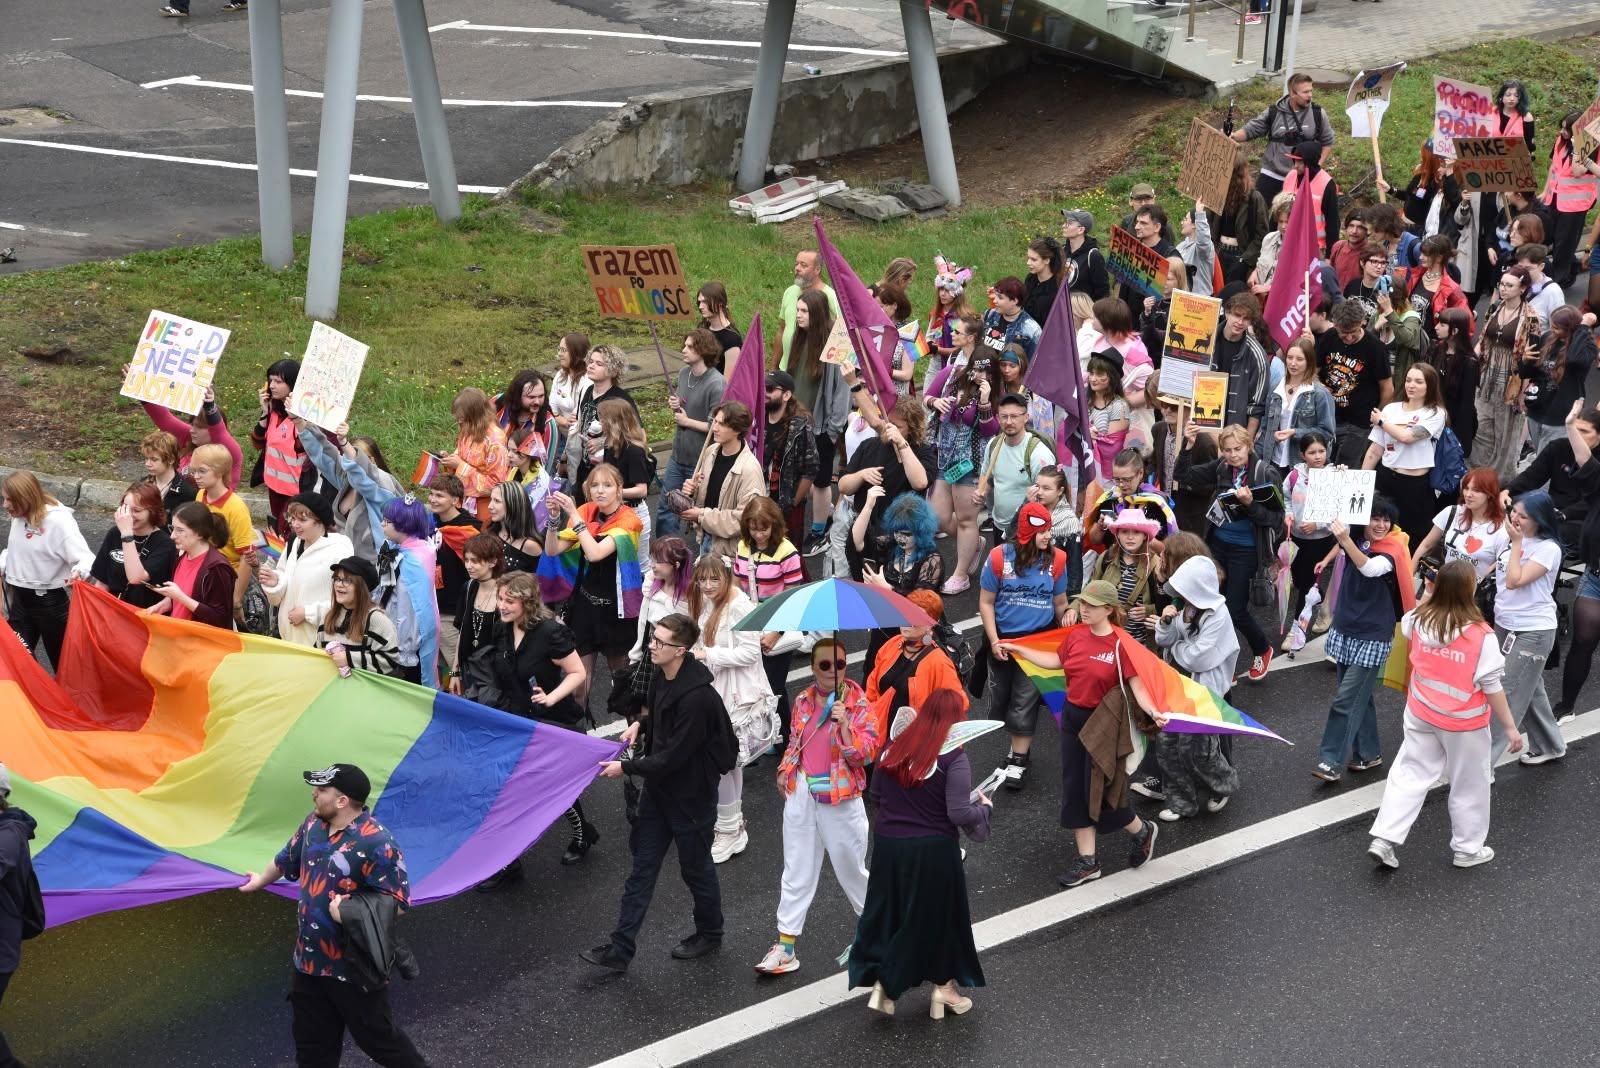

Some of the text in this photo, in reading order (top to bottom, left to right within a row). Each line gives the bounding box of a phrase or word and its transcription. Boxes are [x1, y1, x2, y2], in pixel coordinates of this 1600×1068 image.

[1460, 139, 1508, 157] MAKE
[1470, 159, 1509, 170] LOVE
[1485, 171, 1513, 185] NOT
[587, 248, 677, 276] razem
[145, 317, 182, 345] WE
[298, 391, 335, 421] GAY
[1446, 528, 1464, 549] I
